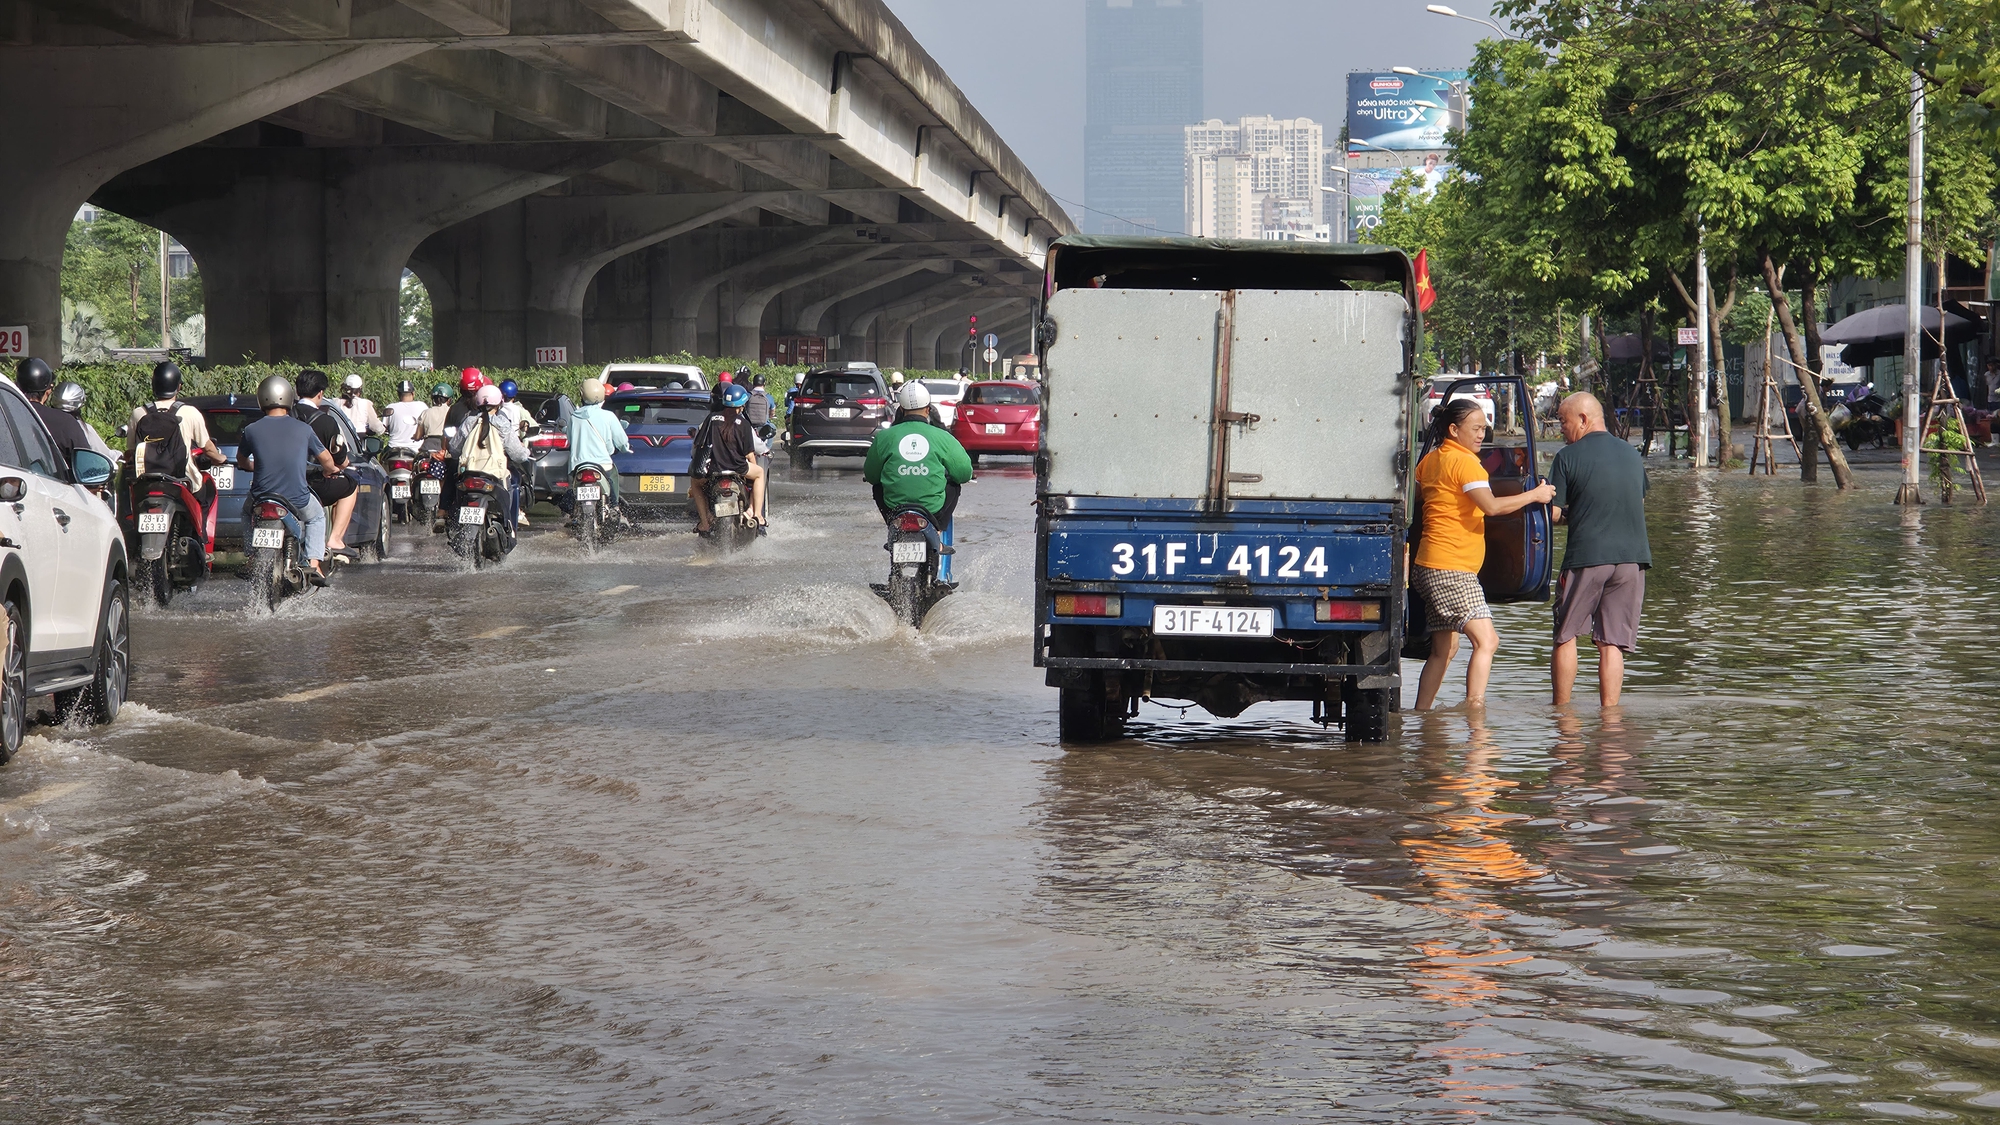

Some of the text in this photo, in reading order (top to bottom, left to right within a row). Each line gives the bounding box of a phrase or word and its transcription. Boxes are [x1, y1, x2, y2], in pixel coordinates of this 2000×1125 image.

[1357, 98, 1378, 107] UỐNG
[1378, 98, 1399, 106] NƯỚC
[343, 338, 376, 355] T130
[537, 349, 563, 362] T131
[898, 462, 929, 476] Grab
[649, 476, 665, 484] 29E
[143, 515, 165, 523] 29-V3
[460, 515, 482, 524] 459.82
[140, 523, 167, 532] 463.33
[257, 529, 279, 538] 29-N1
[253, 537, 281, 547] 429.19
[898, 543, 921, 552] 29-X1
[895, 552, 924, 562] 252.77
[1111, 542, 1187, 575] 31F
[1227, 545, 1329, 578] 4124
[1164, 609, 1261, 633] 31F-4124
